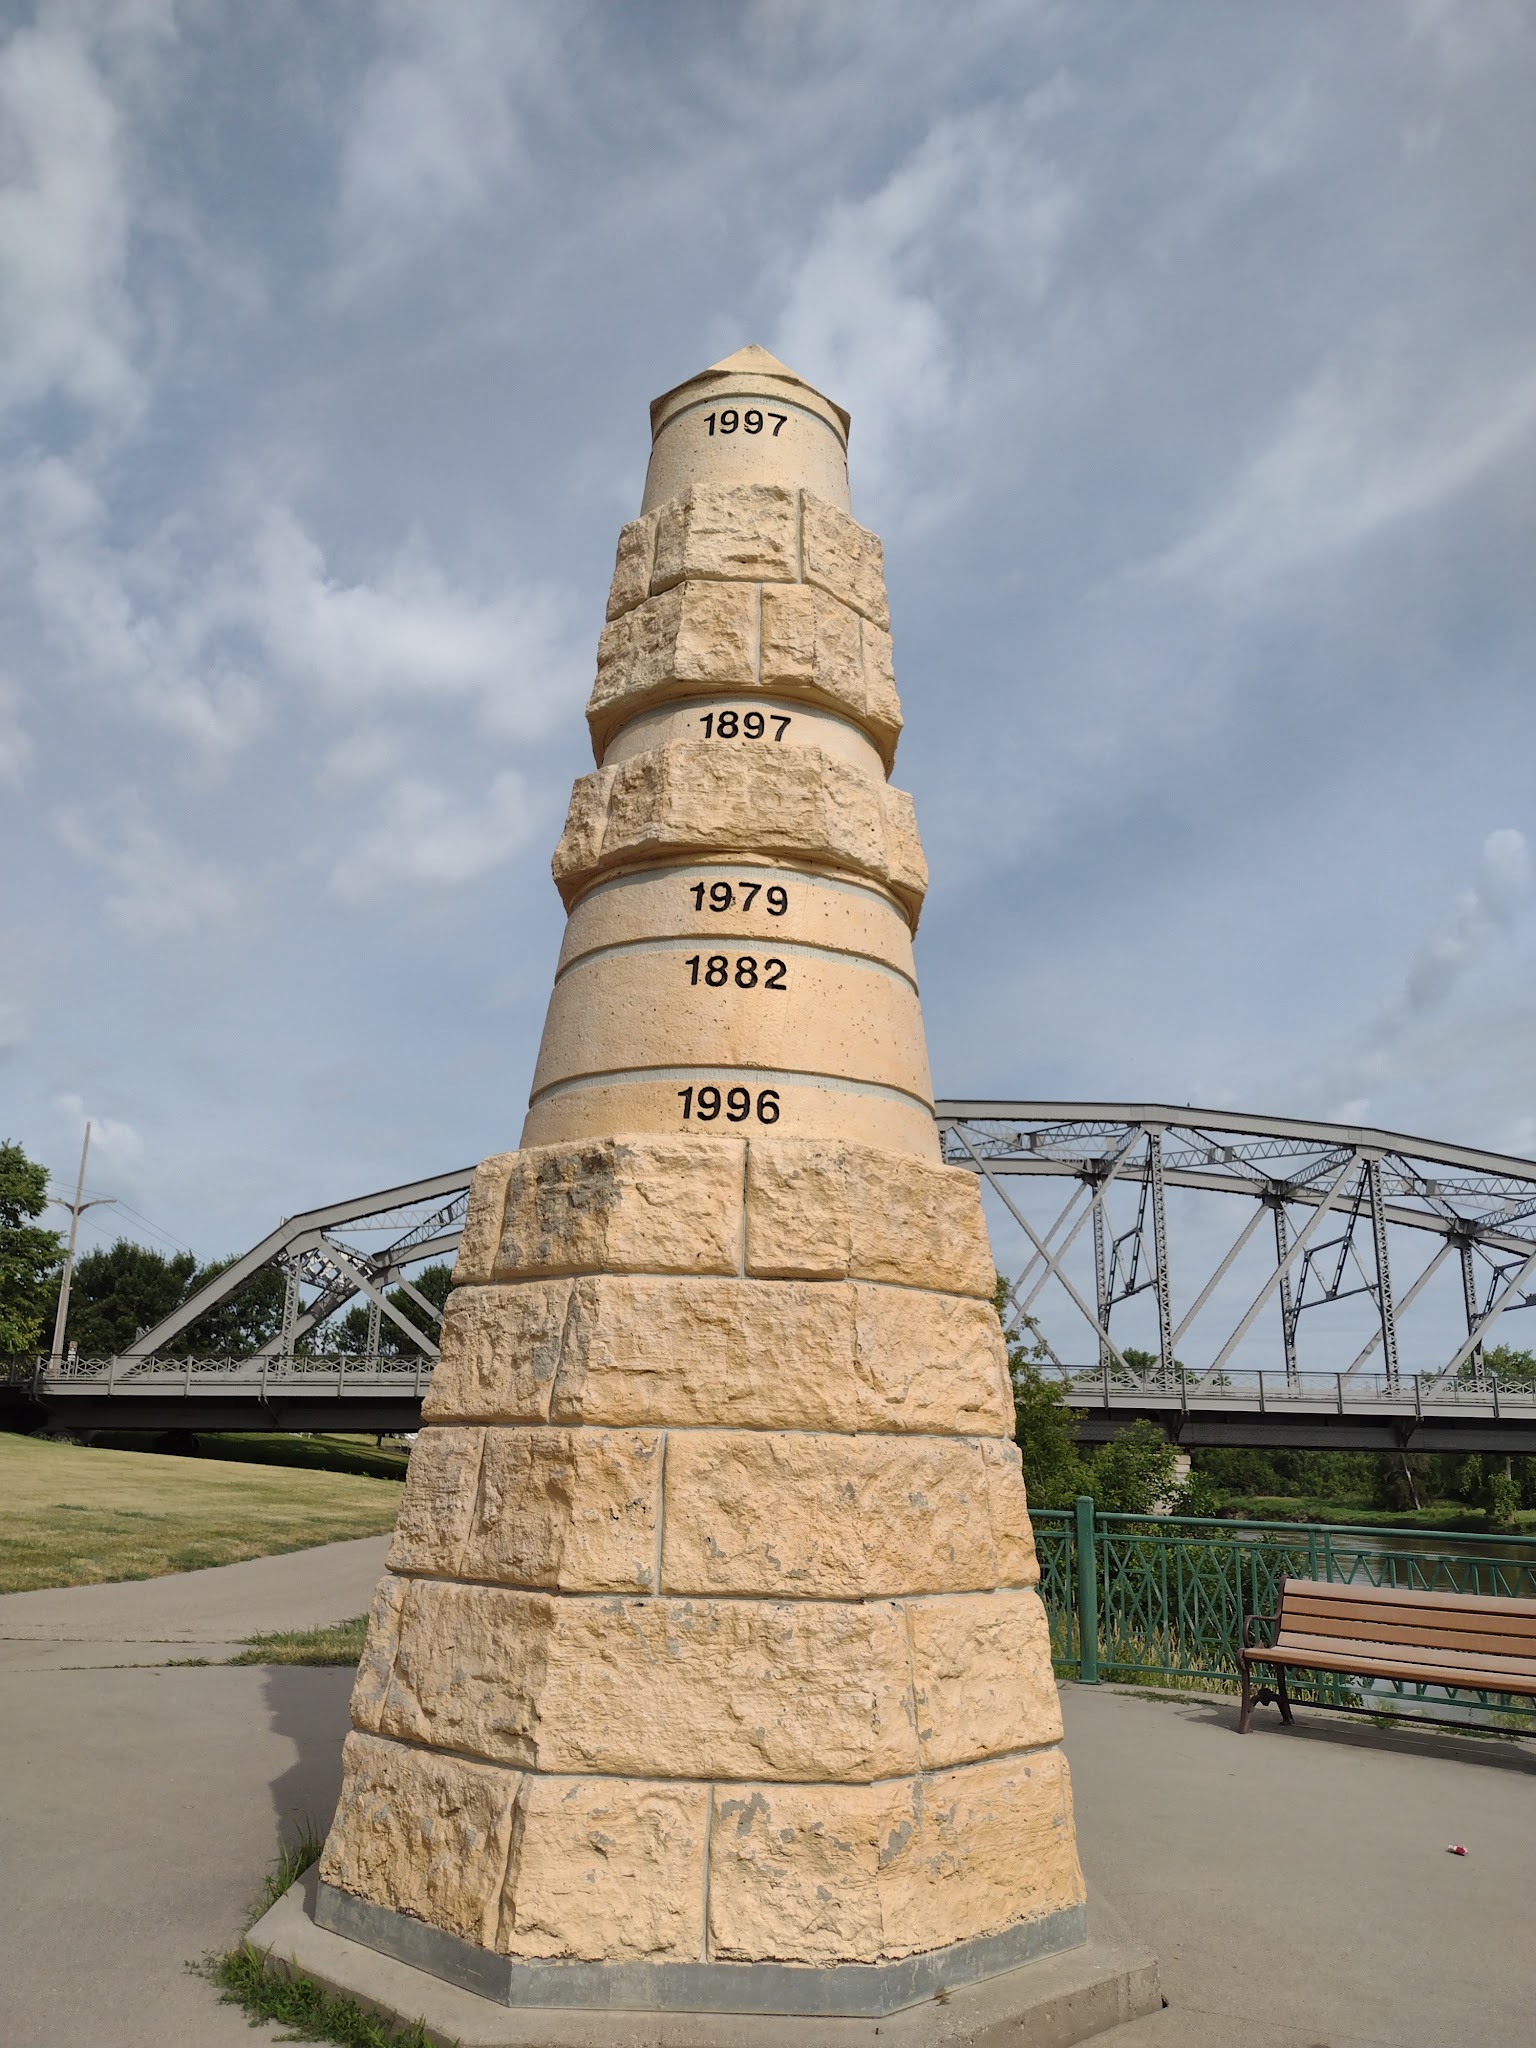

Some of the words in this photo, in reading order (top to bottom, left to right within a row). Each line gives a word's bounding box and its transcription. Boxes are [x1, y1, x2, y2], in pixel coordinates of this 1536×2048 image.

[703, 409, 788, 437] 1997
[699, 710, 792, 742] 1897
[689, 881, 788, 917] 1979
[685, 954, 787, 991] 1882
[677, 1086, 780, 1125] 1996
